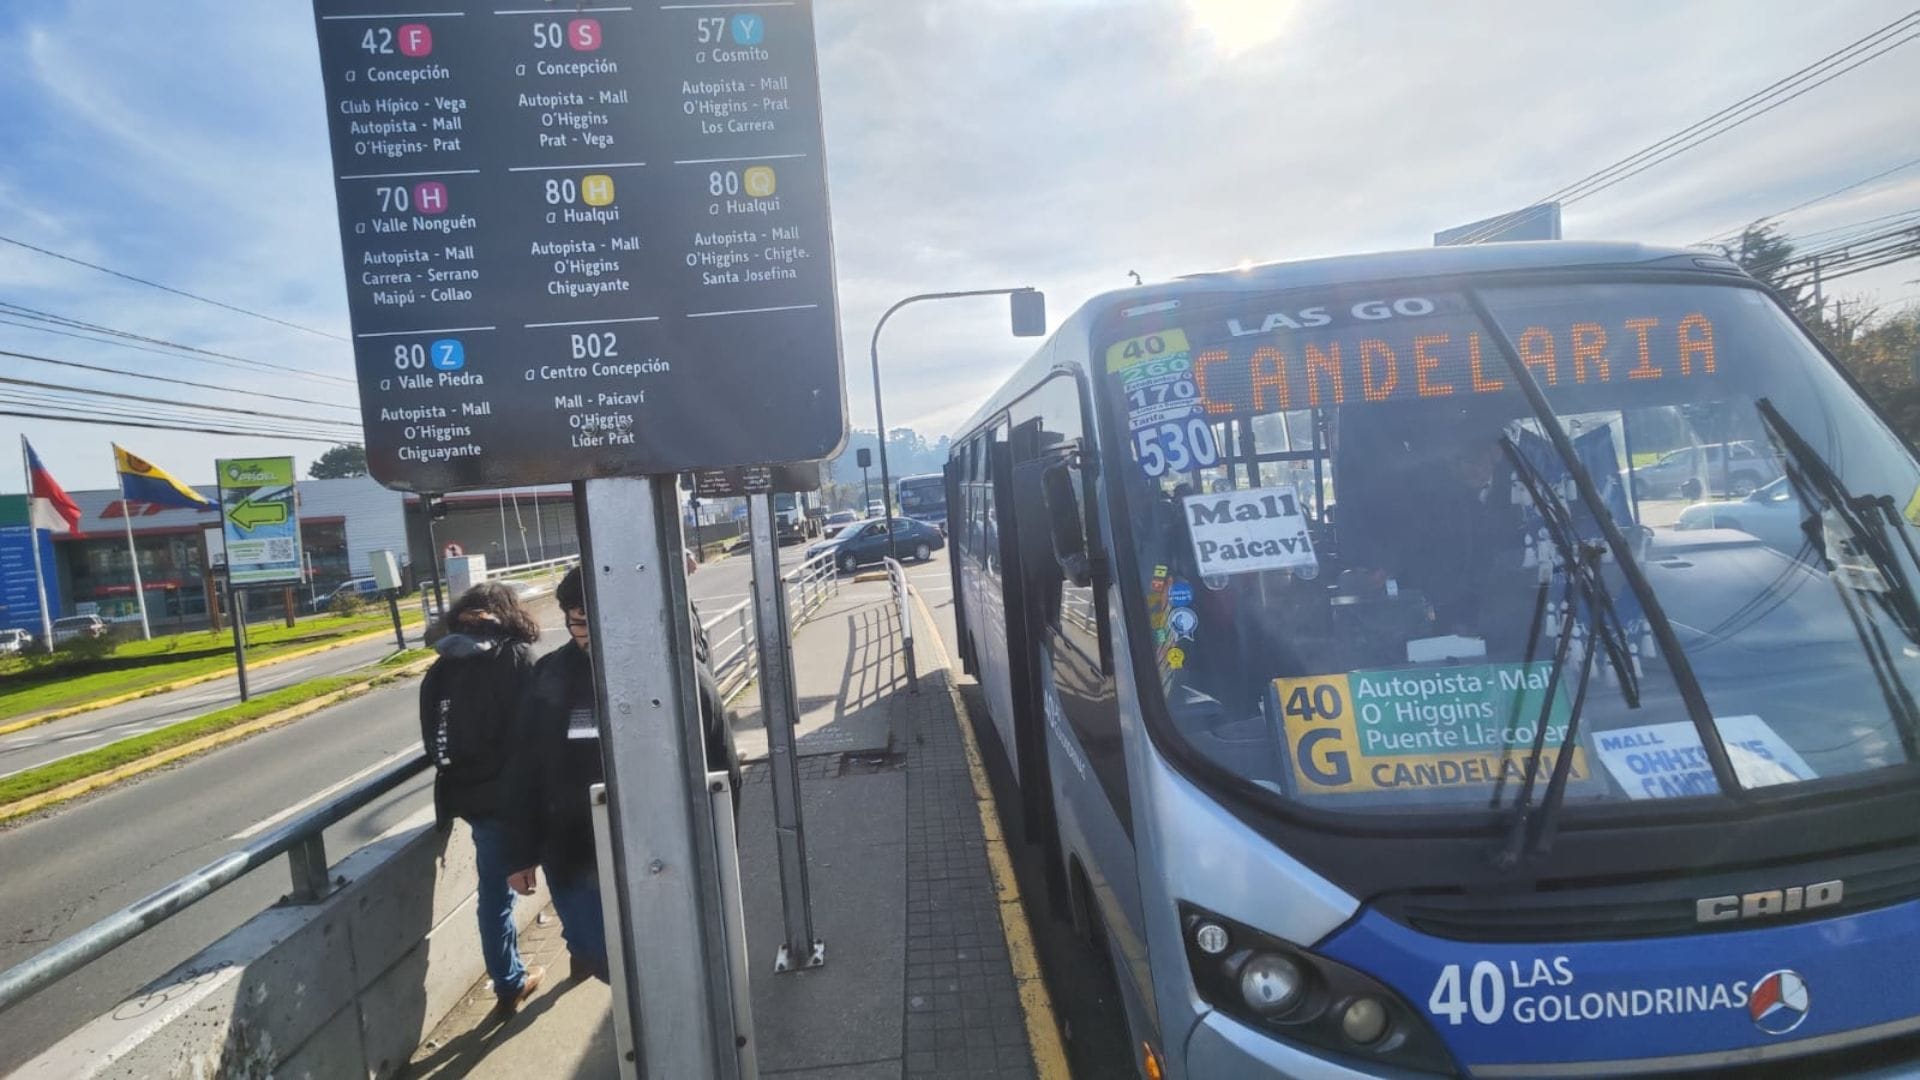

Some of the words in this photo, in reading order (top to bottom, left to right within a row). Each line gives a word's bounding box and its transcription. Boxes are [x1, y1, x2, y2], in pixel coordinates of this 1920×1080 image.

[361, 28, 394, 54] 42
[410, 30, 422, 52] F
[534, 22, 562, 48] 50
[579, 24, 592, 46] S
[698, 18, 725, 43] 57
[740, 19, 754, 40] Y
[696, 51, 706, 63] a
[712, 46, 768, 62] Cosmito
[345, 70, 356, 82] a
[368, 64, 450, 84] Concepción
[516, 64, 526, 76] a
[537, 59, 617, 77] Concepción
[682, 78, 745, 96] Autopista
[761, 76, 788, 90] Mall
[340, 99, 370, 114] Club
[376, 98, 419, 116] Hípico
[434, 96, 467, 114] Vega
[518, 92, 583, 109] Autopista
[600, 89, 628, 104] Mall
[763, 97, 789, 110] Prat
[350, 120, 416, 136] Autopista
[433, 116, 462, 130] Mall
[702, 120, 723, 134] Los
[728, 119, 774, 132] Carrera
[433, 138, 462, 152] Prat
[540, 134, 567, 146] Prat
[582, 132, 614, 148] Vega
[546, 179, 576, 204] 80
[590, 180, 608, 200] H
[710, 171, 738, 196] 80
[377, 186, 408, 212] 70
[422, 188, 440, 208] H
[709, 204, 719, 215] a
[727, 196, 780, 216] Hualqui
[355, 222, 366, 234] a
[372, 218, 408, 232] Valle
[412, 214, 476, 234] Nonguén
[546, 212, 556, 224] a
[564, 206, 619, 226] Hualqui
[531, 240, 596, 257] Autopista
[612, 236, 640, 251] Mall
[694, 230, 757, 248] Autopista
[772, 224, 800, 240] Mall
[364, 249, 429, 267] Autopista
[445, 246, 474, 260] Mall
[764, 246, 810, 263] Chigte.
[362, 272, 412, 285] Carrera
[428, 268, 479, 282] Serrano
[703, 272, 739, 285] Santa
[744, 267, 796, 282] Josefina
[374, 289, 414, 308] Maipú
[432, 288, 472, 302] Collao
[548, 279, 630, 298] Chiguayante
[1227, 307, 1332, 336] LAS
[1351, 297, 1434, 320] GO
[572, 332, 618, 359] B02
[1122, 336, 1165, 358] 40
[394, 344, 426, 369] 80
[440, 345, 456, 366] Z
[1195, 313, 1717, 414] CANDELARIA
[525, 369, 534, 380] a
[540, 366, 587, 379] Centro
[592, 358, 670, 378] Concepción
[1124, 359, 1190, 380] 260
[380, 380, 390, 390] a
[398, 374, 434, 390] Valle
[438, 372, 484, 386] Piedra
[555, 394, 582, 409] Mall
[598, 390, 644, 406] Paicaví
[1130, 380, 1194, 407] 170
[381, 406, 446, 422] Autopista
[462, 402, 490, 416] Mall
[1133, 413, 1164, 426] Tarifa
[609, 432, 635, 444] Prat
[1138, 418, 1216, 476] 530
[398, 444, 482, 462] Chiguayante
[1192, 493, 1299, 526] Mall
[1197, 531, 1312, 564] Paicavi
[1358, 672, 1482, 700] Autopista
[1286, 684, 1342, 722] 40
[1367, 726, 1458, 750] Puente
[1600, 732, 1664, 751] MALL
[1296, 728, 1352, 786] G
[1696, 880, 1844, 923] CAIO
[1510, 956, 1573, 988] LAS
[1428, 960, 1506, 1026] 40
[1514, 981, 1748, 1024] GOLONDRINAS
